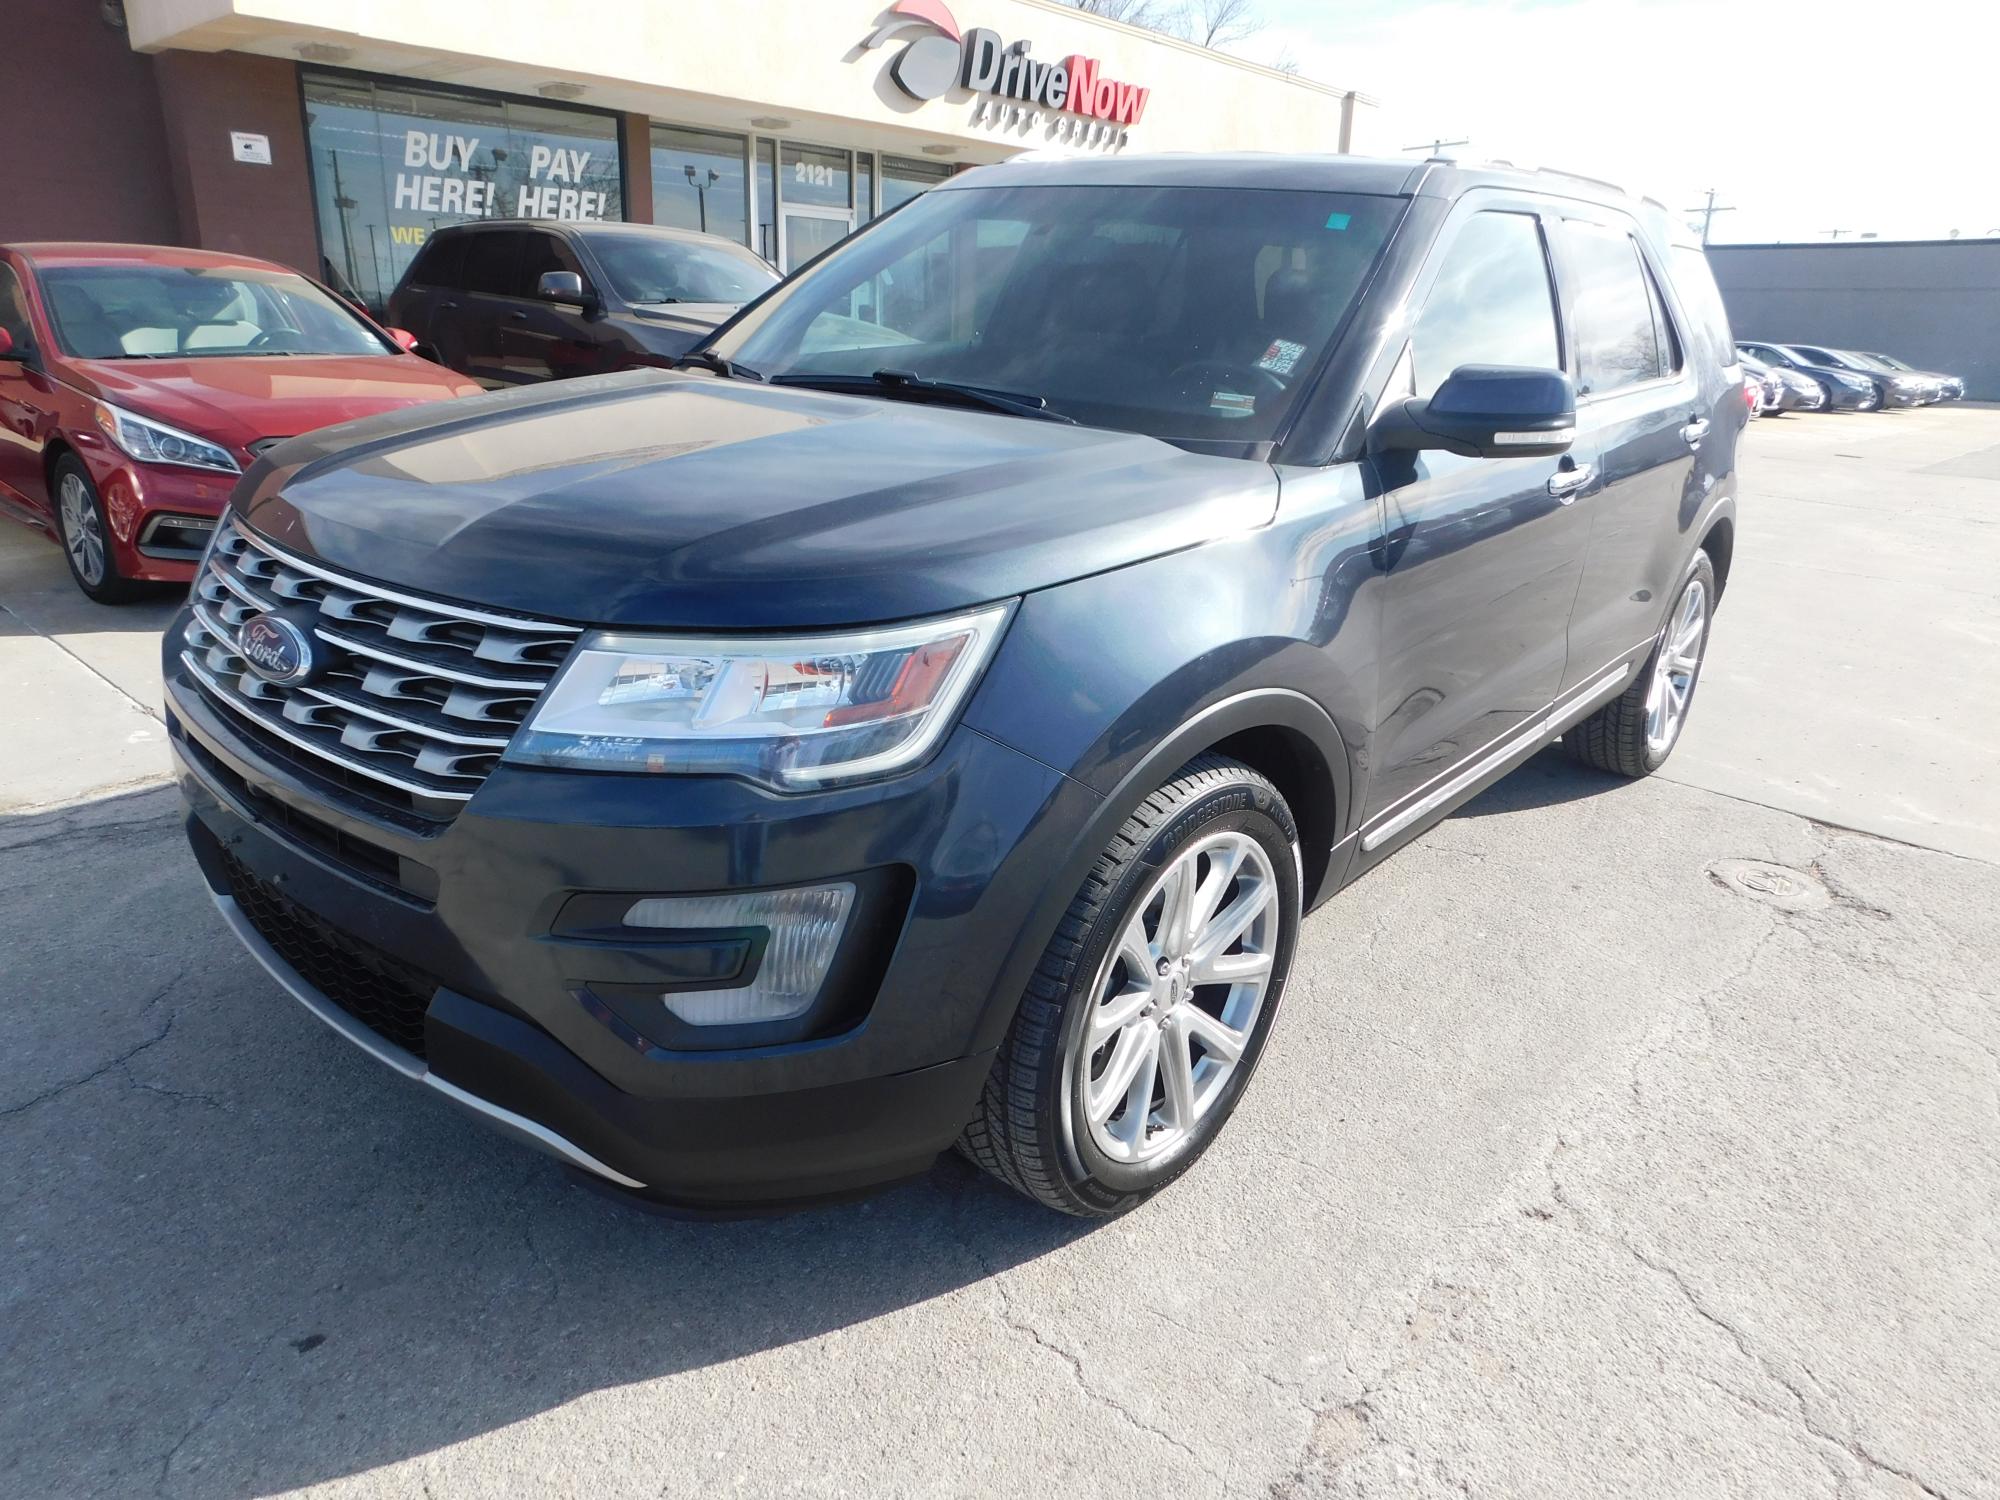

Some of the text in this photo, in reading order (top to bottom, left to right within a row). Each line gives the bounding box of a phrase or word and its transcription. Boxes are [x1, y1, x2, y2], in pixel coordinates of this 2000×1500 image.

[964, 27, 1150, 124] DriveNow
[980, 101, 1129, 148] AUTO CREDIT
[404, 130, 480, 172] BUY
[529, 145, 592, 184] PAY
[394, 173, 496, 216] HERE!
[795, 161, 833, 187] 2121
[517, 184, 607, 222] HERE!
[389, 225, 426, 246] WE
[245, 624, 289, 671] Ford
[1162, 792, 1248, 849] BRIDGESTONE
